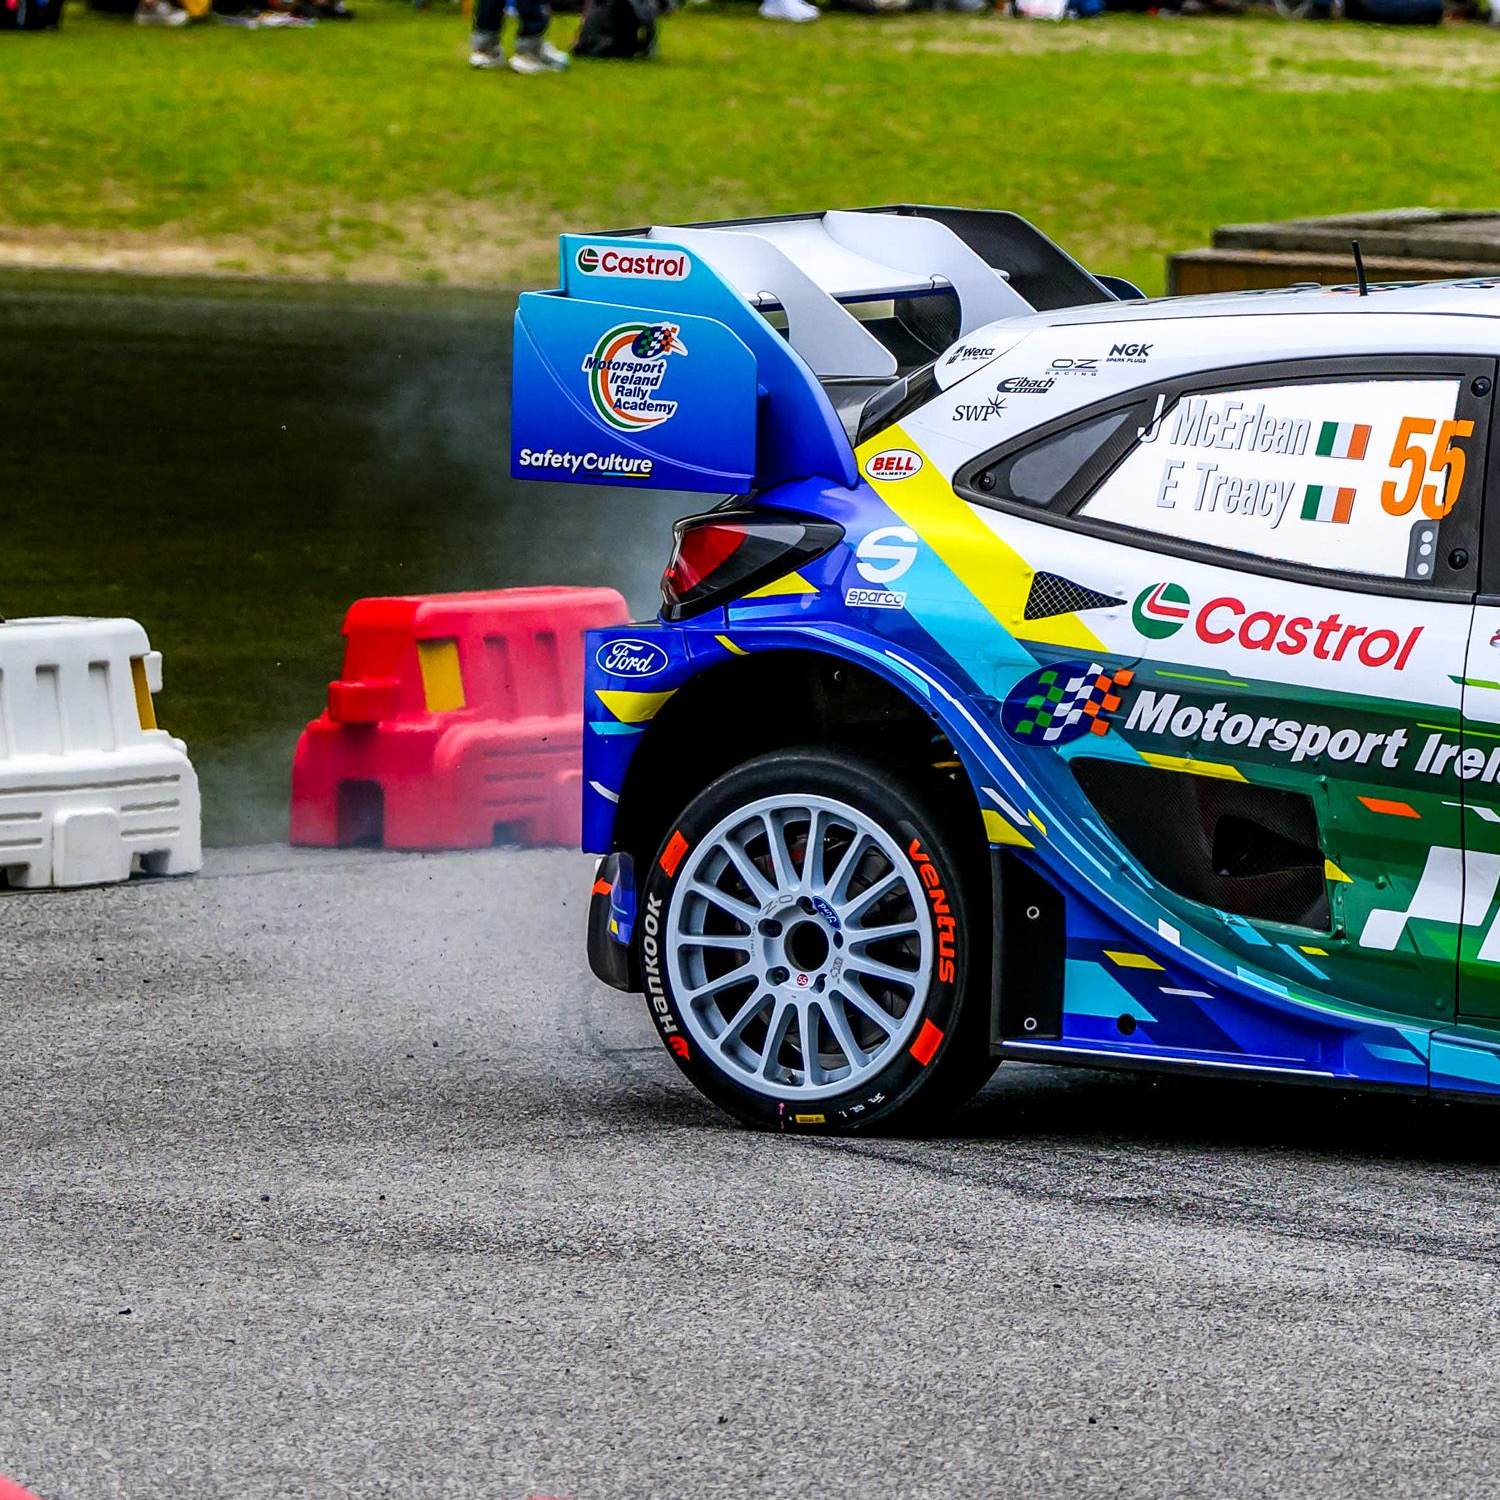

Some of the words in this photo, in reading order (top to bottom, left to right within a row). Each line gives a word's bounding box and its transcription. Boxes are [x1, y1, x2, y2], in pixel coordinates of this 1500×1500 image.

[601, 251, 685, 277] Castrol
[963, 347, 996, 358] Wera
[1108, 343, 1154, 357] NGK
[585, 357, 665, 375] Motorsport
[609, 372, 660, 388] Ireland
[997, 377, 1056, 394] Eibach
[615, 385, 649, 402] Rally
[613, 397, 676, 416] Academy
[952, 405, 996, 421] SWP
[1137, 393, 1167, 443] J
[1169, 397, 1312, 456] McErlean
[519, 448, 653, 474] SafetyCulture
[872, 456, 914, 471] BELL
[1380, 416, 1476, 520] 55
[1156, 458, 1185, 509] E
[1193, 461, 1296, 529] Treacy
[848, 589, 905, 606] sparco
[1194, 596, 1425, 671] Castrol
[605, 641, 653, 673] Ford
[1125, 690, 1410, 770] Motorsport
[797, 975, 808, 985] 55
